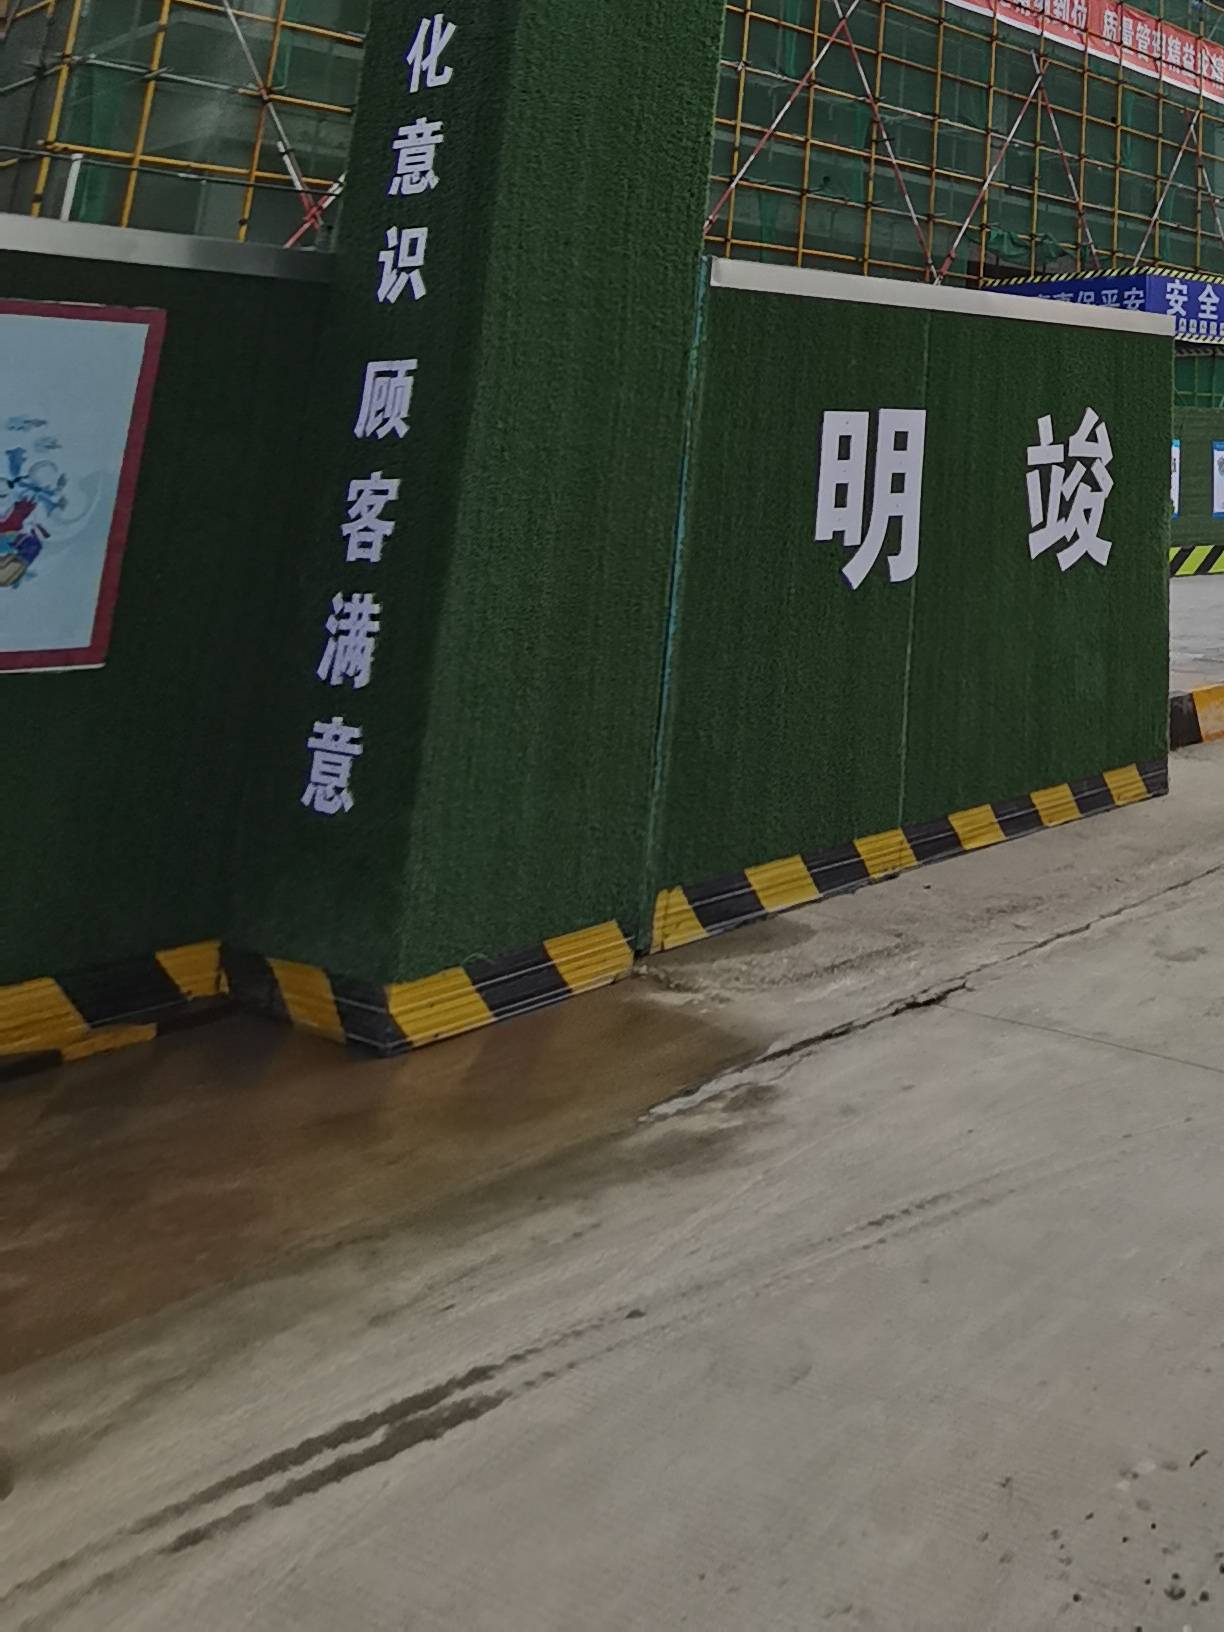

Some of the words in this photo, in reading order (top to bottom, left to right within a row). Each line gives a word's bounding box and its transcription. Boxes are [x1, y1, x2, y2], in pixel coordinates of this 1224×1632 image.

[300, 357, 419, 815] 顾客满意
[814, 406, 1114, 590] 明竣
